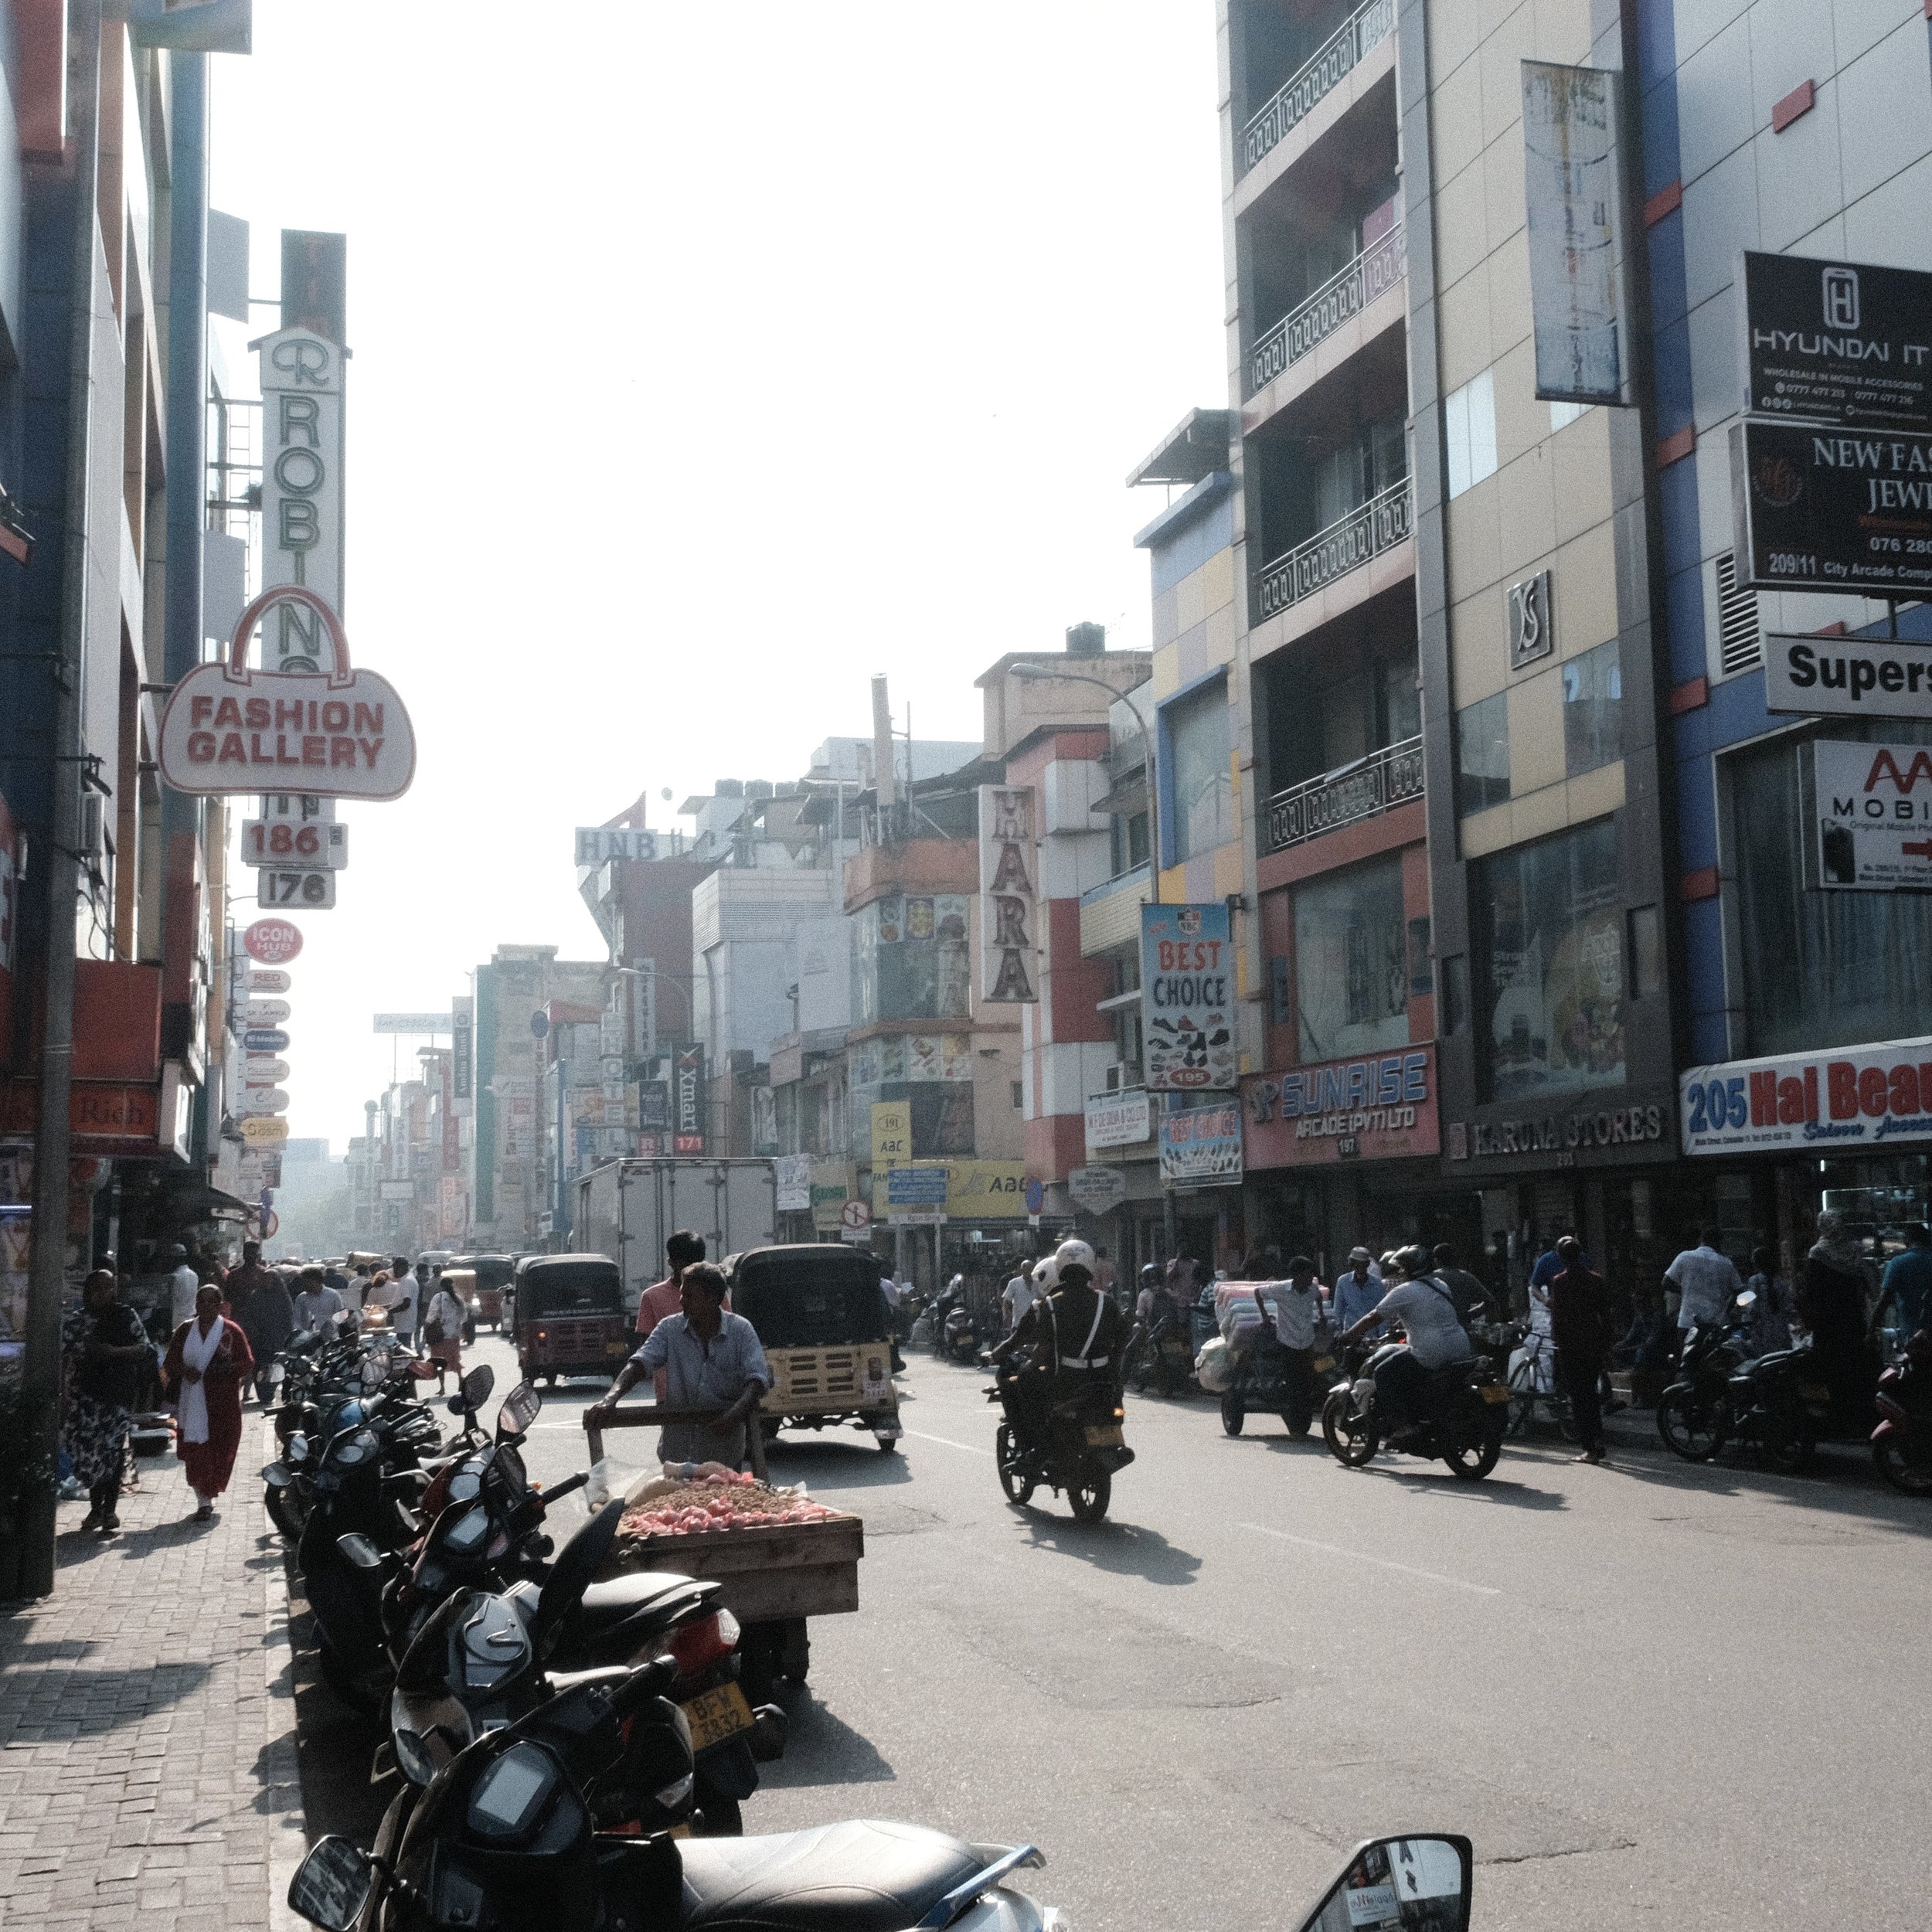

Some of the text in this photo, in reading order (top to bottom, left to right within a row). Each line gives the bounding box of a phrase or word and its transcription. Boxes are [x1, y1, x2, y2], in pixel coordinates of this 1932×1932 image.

[1753, 328, 1930, 366] HYUNDAI IT
[1763, 367, 1817, 380] WHOLESALE
[1818, 372, 1828, 382] IN
[1811, 437, 1883, 470] NEW
[1823, 561, 1849, 577] City
[1852, 563, 1894, 577] Arcade
[1787, 645, 1932, 701] Super
[190, 696, 385, 735] FASHION
[187, 731, 386, 770] GALLERY
[250, 824, 319, 854] 186
[580, 831, 656, 861] HNB
[268, 872, 326, 903] 176
[253, 927, 295, 943] ICON
[256, 942, 291, 951] HUB
[1157, 939, 1223, 972] BEST
[1152, 977, 1226, 1007] CHOICE
[1175, 1071, 1206, 1083] 195
[1282, 1052, 1429, 1118] SUNRISE
[1687, 1077, 1747, 1133] 205
[1749, 1066, 1819, 1128] Hal
[1295, 1114, 1348, 1139] ARCADE
[1388, 1106, 1416, 1129] LTD
[1566, 1105, 1661, 1147] STORES
[680, 1136, 702, 1150] 171
